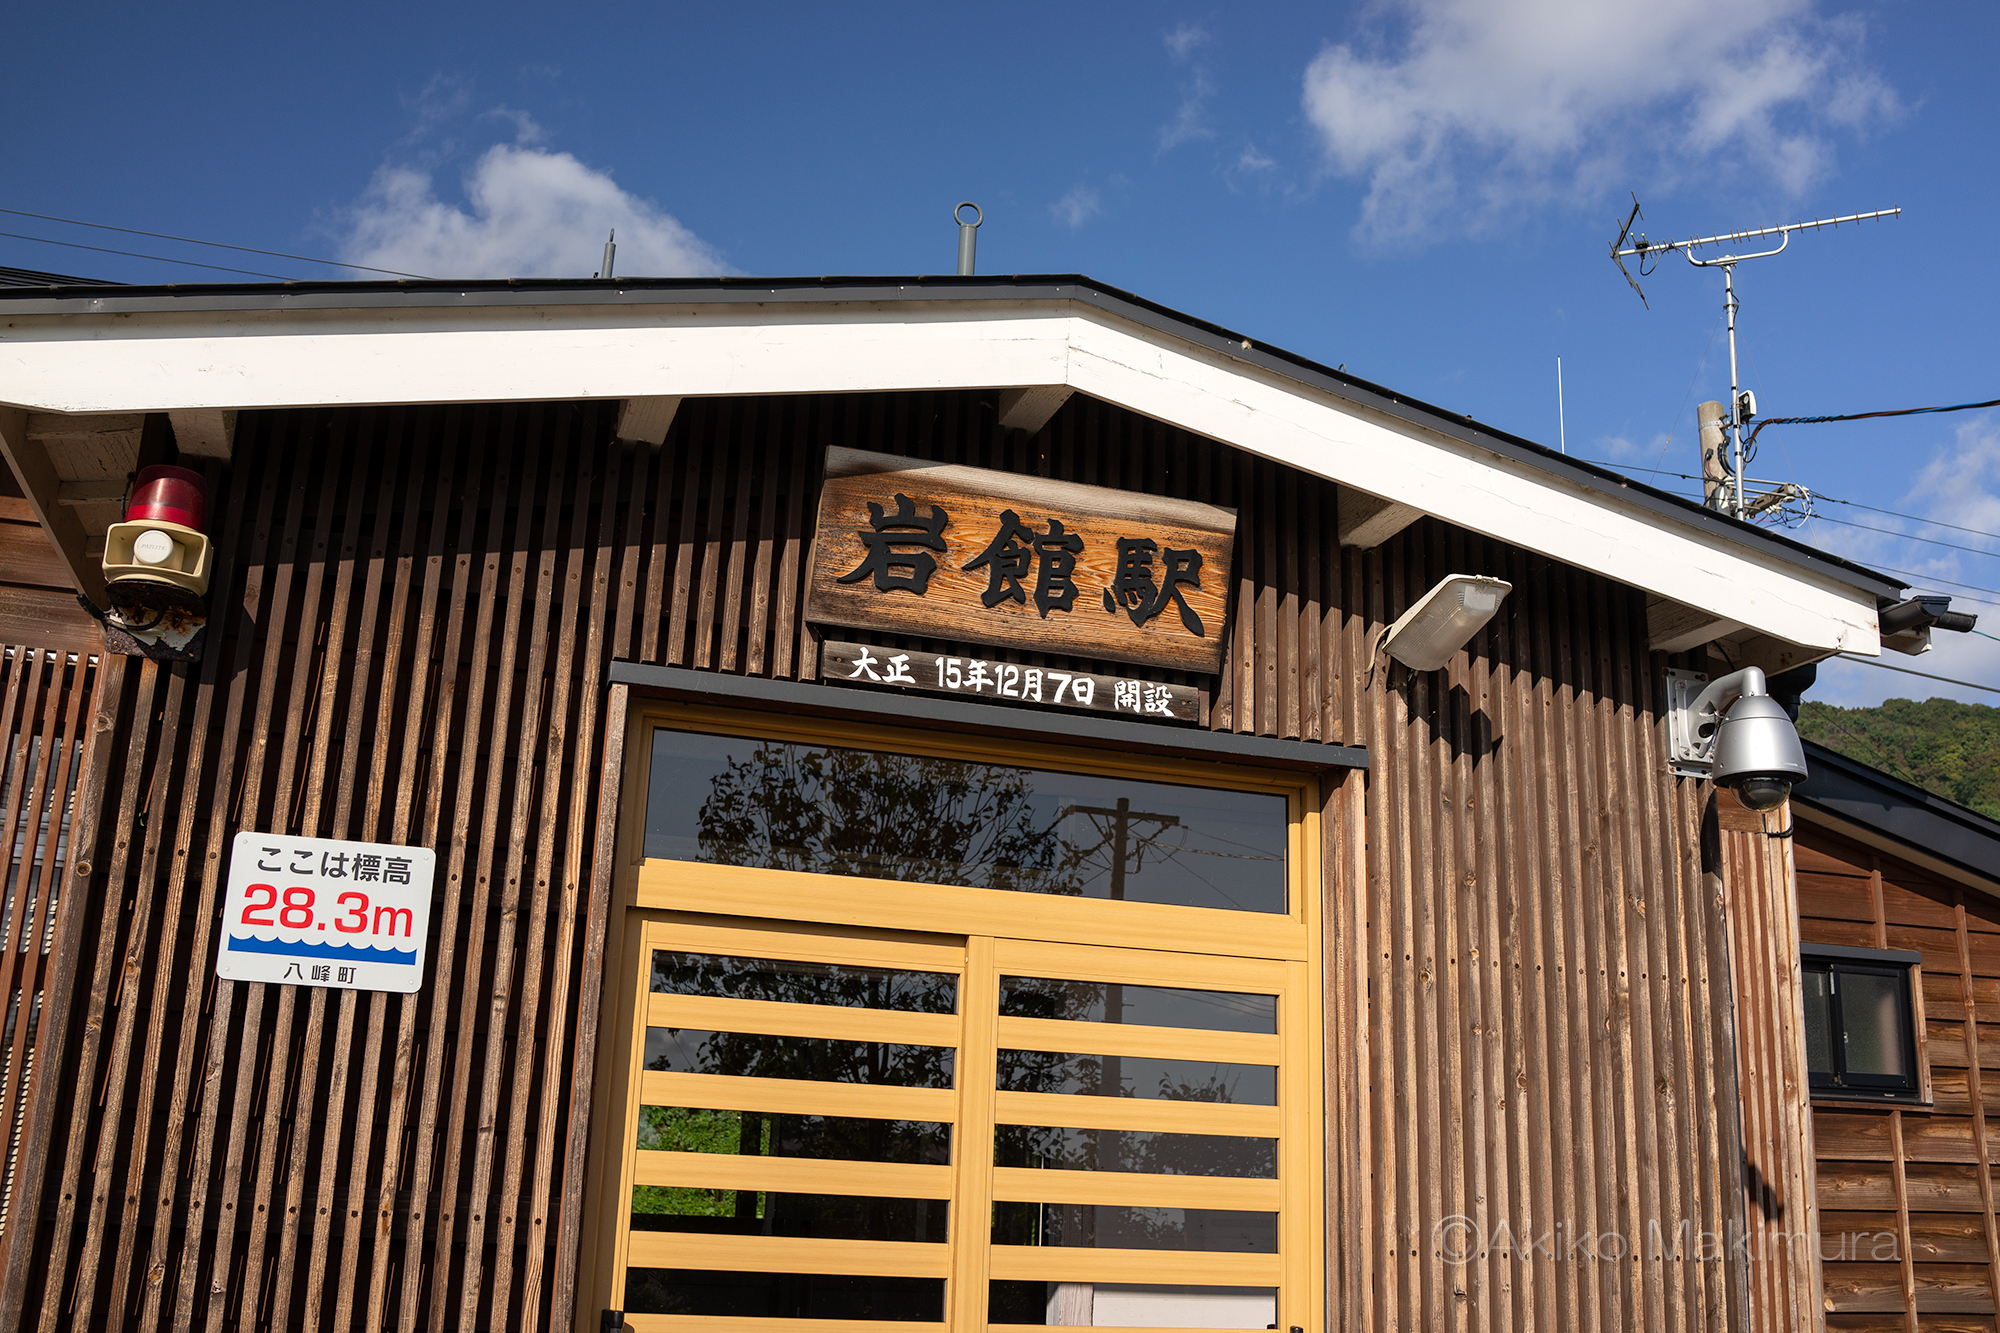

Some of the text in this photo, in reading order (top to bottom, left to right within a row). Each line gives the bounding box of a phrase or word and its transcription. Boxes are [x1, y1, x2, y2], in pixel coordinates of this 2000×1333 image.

[836, 492, 1205, 637] 岩館駅
[848, 646, 1175, 717] 大正 15年12月7日 開設
[257, 846, 413, 886] ここは標高
[240, 882, 413, 938] 28.3m
[283, 962, 357, 985] 八峰町
